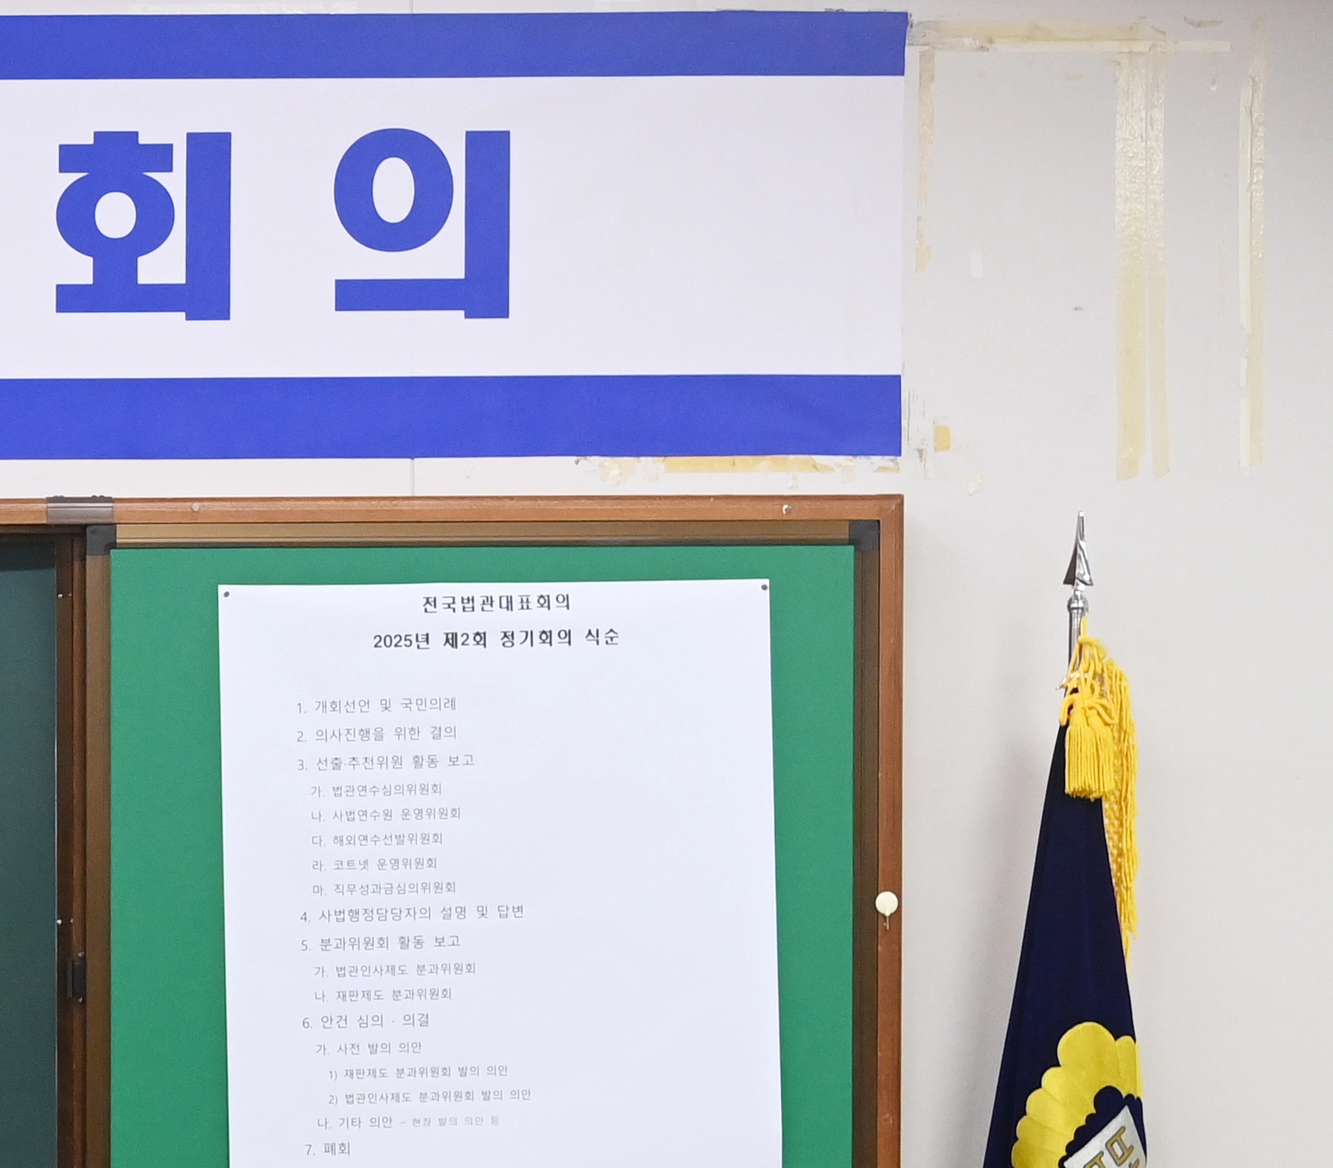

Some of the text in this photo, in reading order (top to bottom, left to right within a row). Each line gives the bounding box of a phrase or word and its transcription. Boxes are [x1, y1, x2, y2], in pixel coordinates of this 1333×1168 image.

[422, 593, 571, 614] 전국법관대표회의
[373, 627, 619, 651] 2025년 제2회 정기회의 식순
[296, 696, 457, 715] 1. 개회선언 및 국민의례
[296, 724, 457, 743] 2. 의사진행을 위한 결의
[297, 753, 475, 772] 3. 선출·추천위원 활동 보고
[310, 782, 442, 799] 가. 법관연수심의위원회
[310, 806, 461, 823] 나. 사법연수원 운영위원회
[311, 831, 443, 848] 다. 해외연수선발위원회
[311, 856, 438, 873] 라. 코트넷 운영위원회
[312, 880, 456, 897] 마. 직무성과금심의위원회
[299, 904, 524, 924] 4. 사법행정담당자의 설명 및 답변
[300, 934, 461, 953] 5. 분과위원회 활동 보고
[314, 962, 476, 979] 가. 법관인사제도 분과위원회
[314, 987, 452, 1004] 나. 재판제도 분과위원회
[301, 1012, 430, 1030] 6. 안건 심의 의결
[315, 1041, 423, 1057] 가. 사전 발의 의안
[304, 1141, 351, 1157] 7. 폐회
